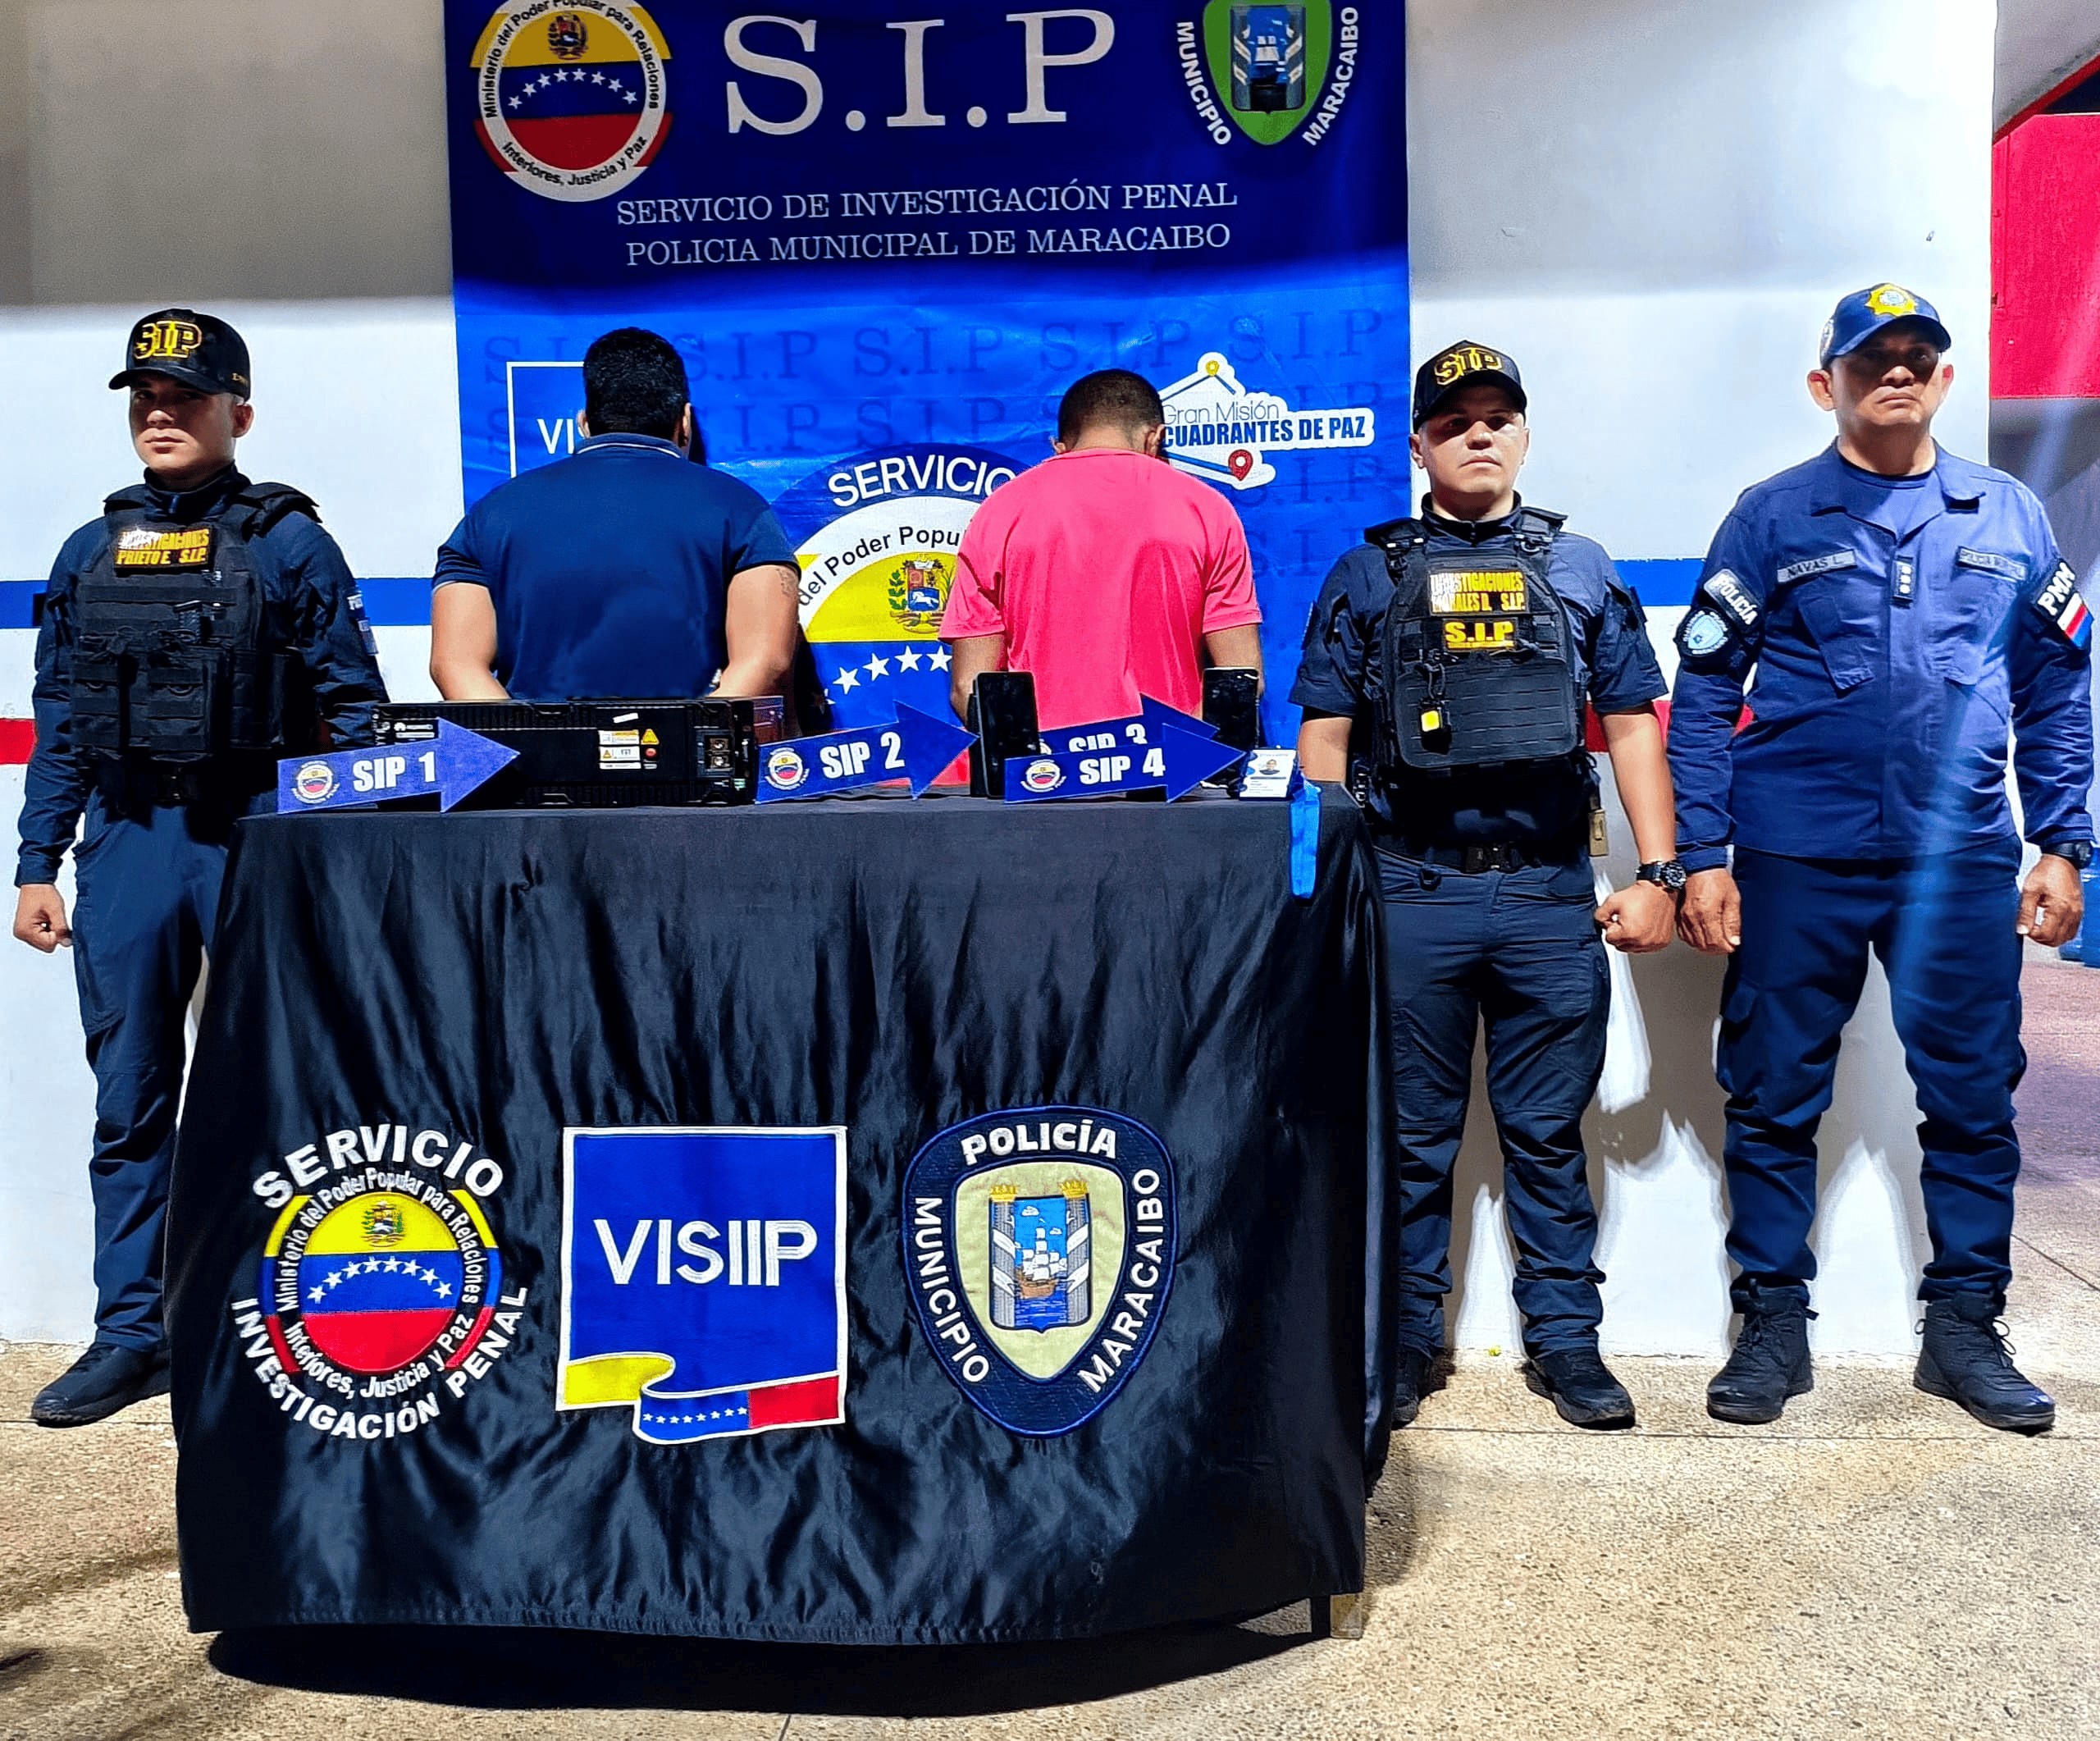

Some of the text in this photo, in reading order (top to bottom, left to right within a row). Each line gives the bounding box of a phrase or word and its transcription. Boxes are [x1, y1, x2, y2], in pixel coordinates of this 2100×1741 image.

[497, 25, 515, 47] del
[510, 1, 550, 26] Poder
[605, 7, 635, 31] para
[725, 8, 1116, 135] S.I.P
[1176, 21, 1231, 146] MUNICIPIO
[1302, 7, 1358, 146] MARACAIBO
[568, 164, 618, 186] Justicia
[617, 158, 627, 171] y
[624, 136, 647, 159] Paz
[618, 178, 1238, 226] SERVICIO DE INVESTIGACIÓN PENAL
[626, 223, 1230, 266] POLICIA MUNICIPAL DE MARACAIBO
[1433, 347, 1503, 386] SIP
[1162, 400, 1280, 425] Gran Misión
[1163, 416, 1366, 447] CUADRANTES DE PAZ
[824, 534, 891, 577] Poder
[899, 526, 961, 549] Popu
[2037, 562, 2075, 616] PMM
[1445, 621, 1514, 642] S.I.P
[353, 756, 405, 793] SIP
[419, 752, 436, 783] 1
[819, 742, 870, 779] SIP
[880, 731, 905, 770] 2
[1079, 755, 1131, 785] SIP
[1142, 747, 1166, 777] 4
[252, 1123, 504, 1209] SERVICIO
[961, 1119, 1117, 1166] POLICÍA
[275, 1167, 488, 1313] Ministerio del Poder Popular para Relaciones
[593, 1219, 818, 1286] VISIIP
[915, 1197, 989, 1383] MUNICIPIO
[1077, 1168, 1164, 1394] MARACAIBO
[231, 1287, 528, 1440] INVESTIGACIÓN PENAL
[285, 1314, 474, 1400] Interiores, Justicia y Paz
